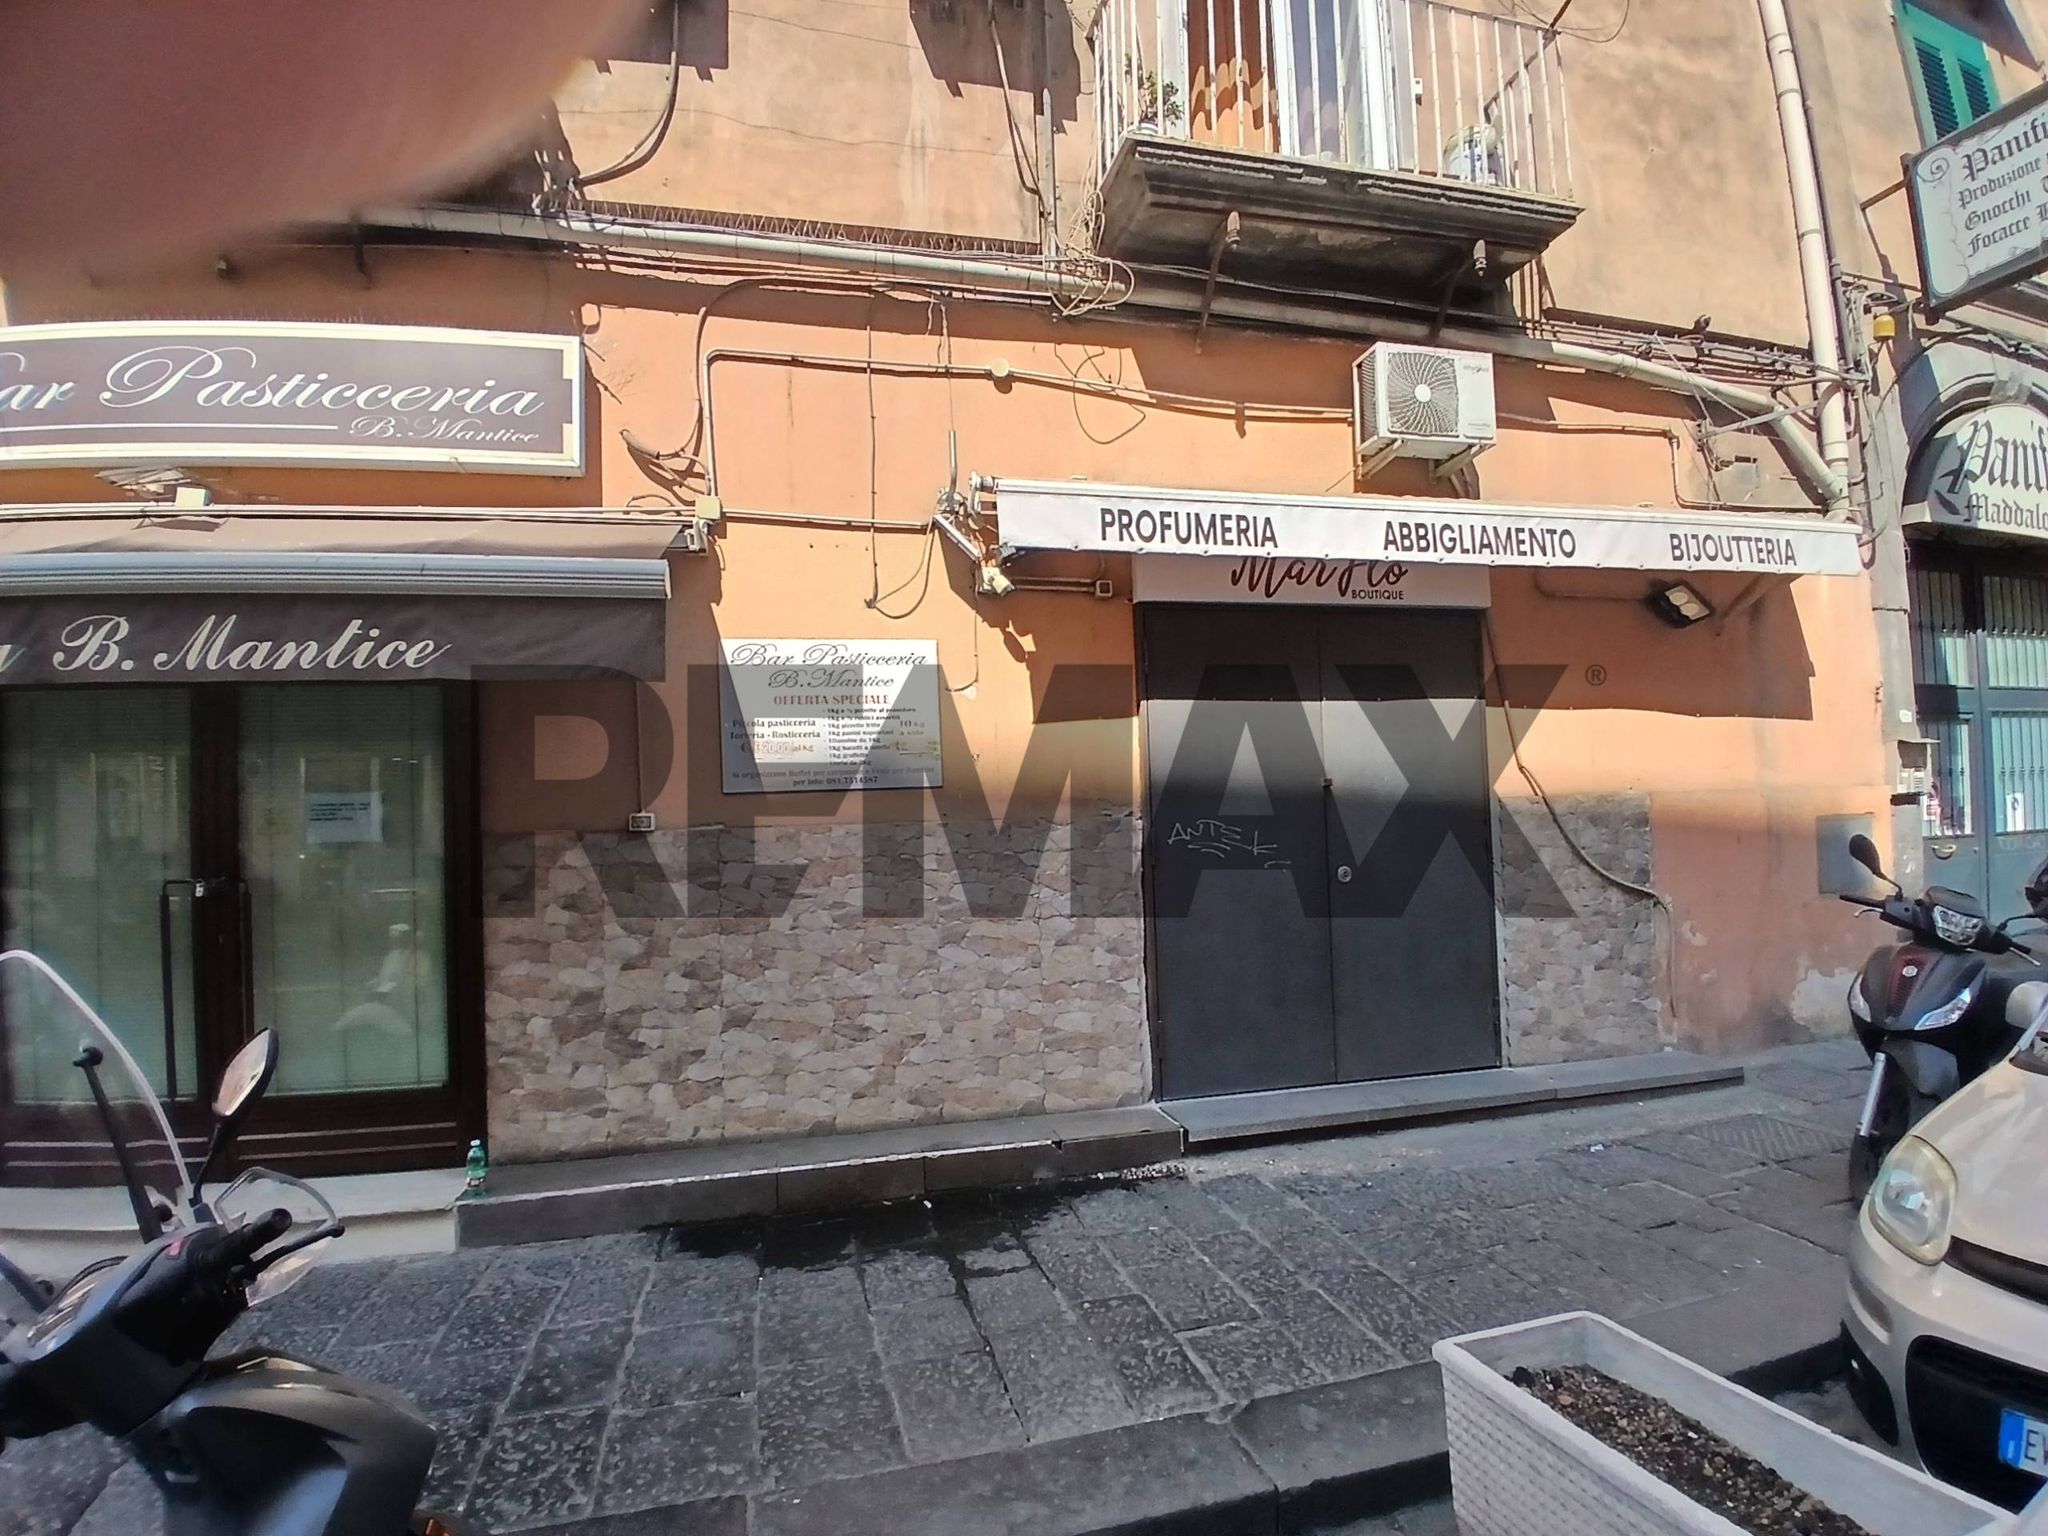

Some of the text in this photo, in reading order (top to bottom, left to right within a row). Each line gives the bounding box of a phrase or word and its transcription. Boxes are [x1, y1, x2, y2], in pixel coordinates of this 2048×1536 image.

[1958, 158, 2040, 210] Produzione
[1965, 190, 2032, 230] Gnocchi
[1968, 215, 2030, 258] Focacce
[0, 345, 545, 417] ar Pasticceria
[408, 416, 540, 443] Mantice
[1101, 508, 1797, 566] PROFUMERIA ABBIGLIAMENTO BIJOUTTERIA
[1352, 589, 1405, 600] BOUTIQUE
[53, 615, 134, 671] B.
[154, 613, 451, 671] Mantice
[731, 643, 928, 667] Bar Pasticceria
[807, 669, 894, 688] Mantice
[774, 694, 889, 705] OFFERTA SPECIALE
[768, 718, 816, 728] pasticceria
